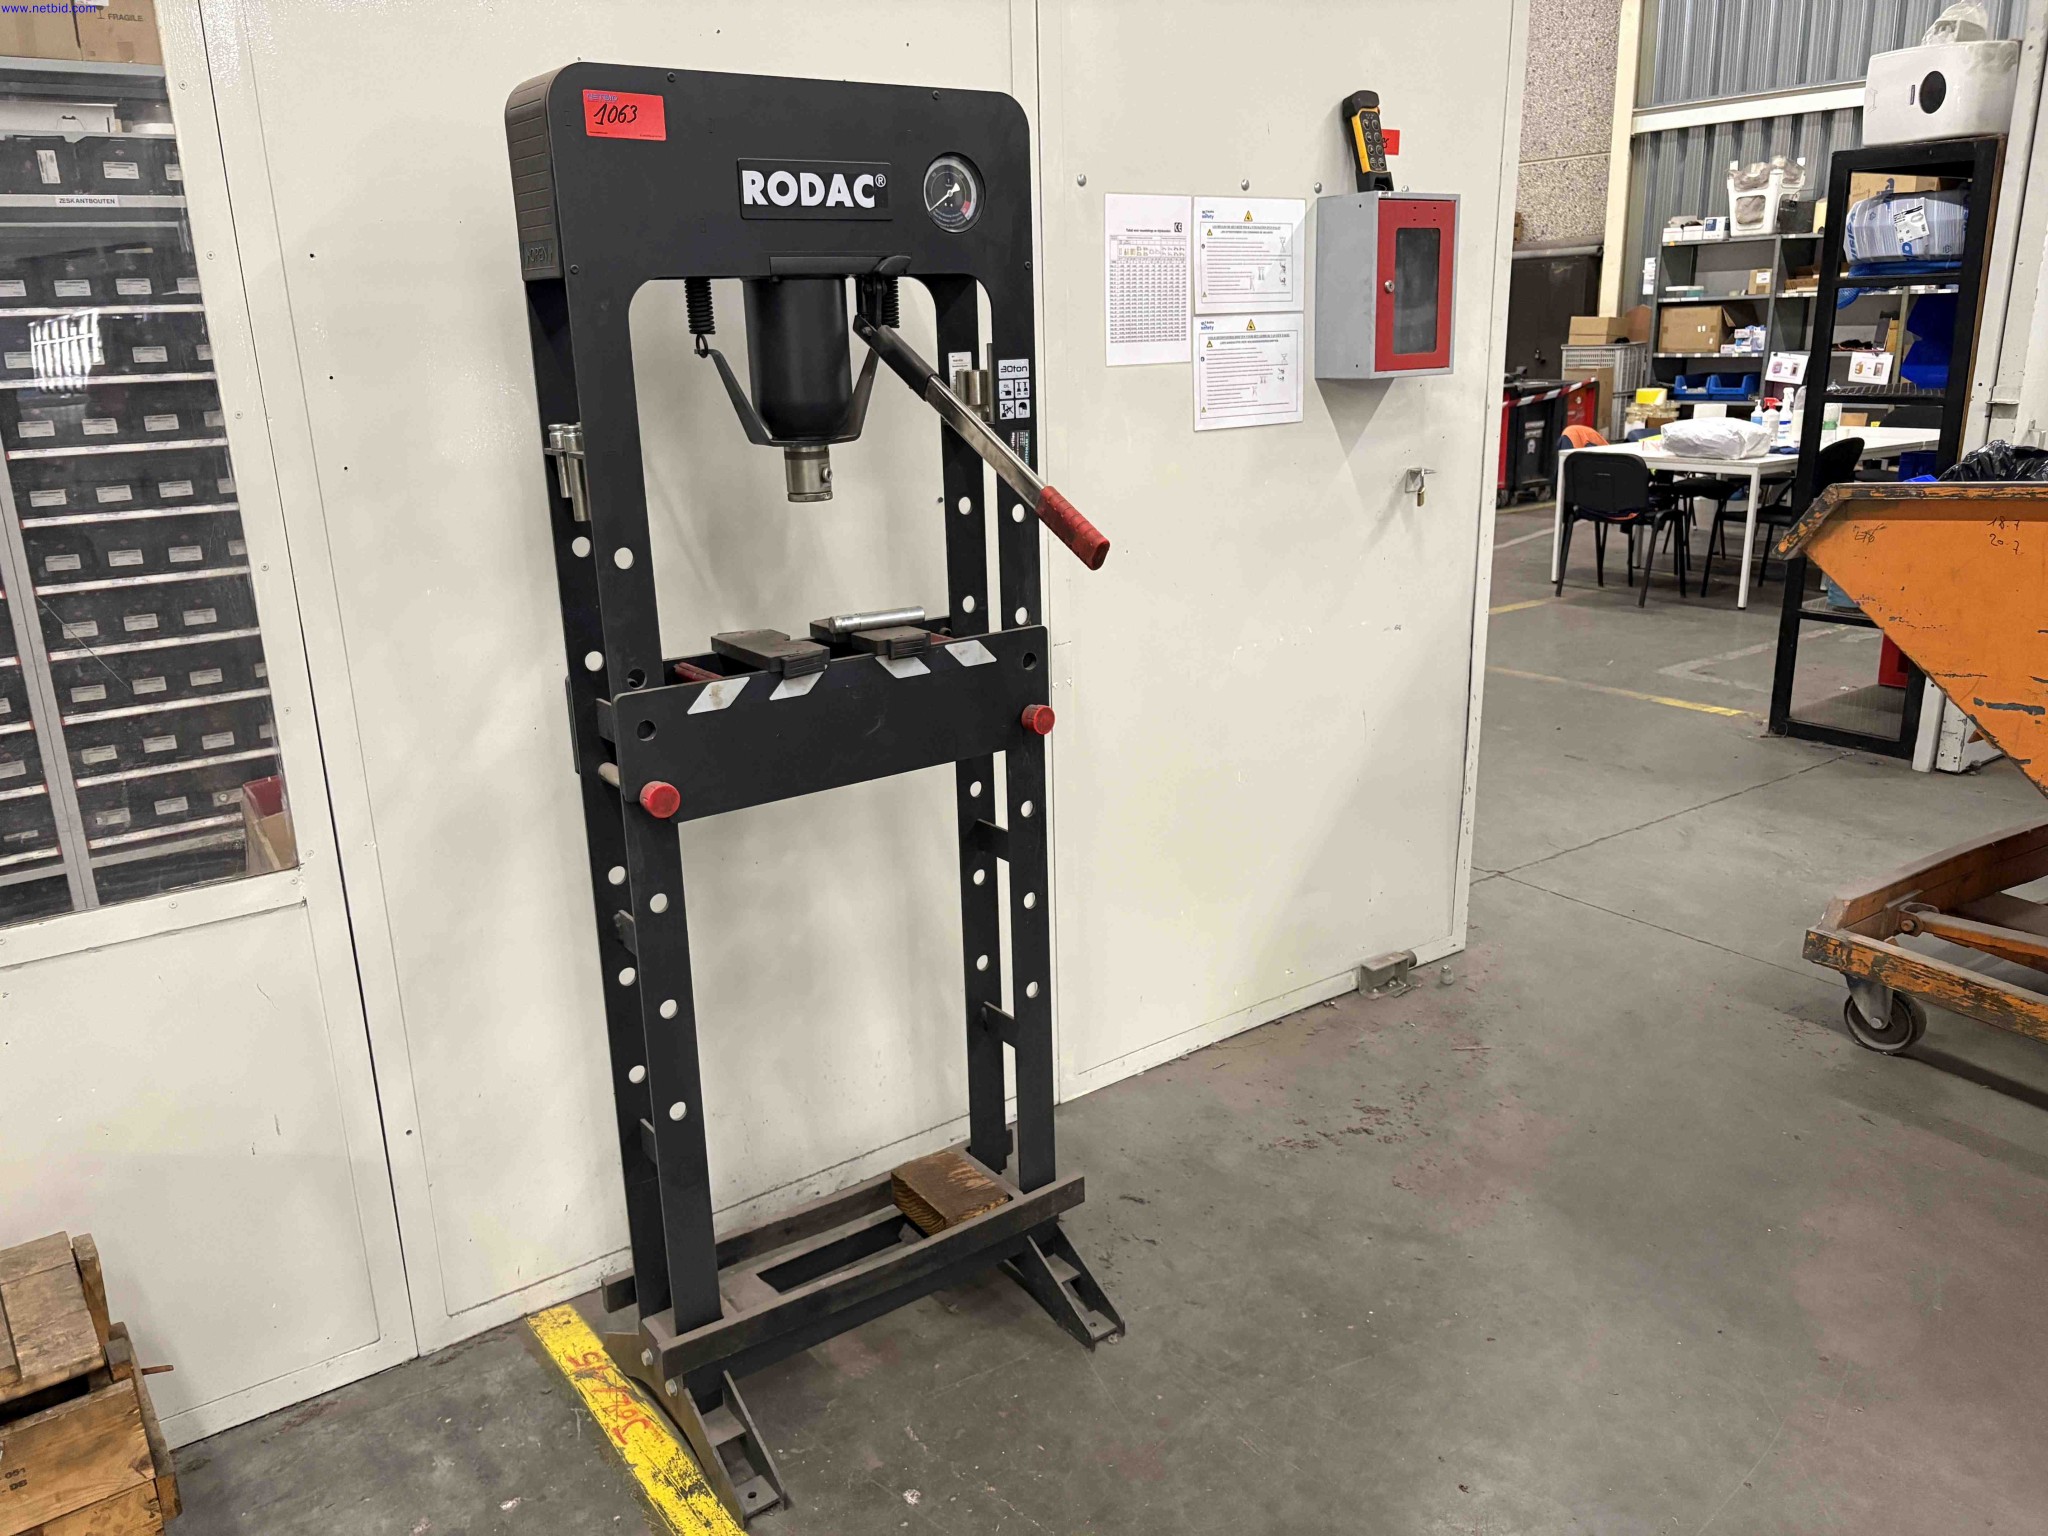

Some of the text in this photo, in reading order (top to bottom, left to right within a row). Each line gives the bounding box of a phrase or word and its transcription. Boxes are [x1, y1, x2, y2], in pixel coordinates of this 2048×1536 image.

[107, 13, 144, 22] FRAGILE
[593, 103, 638, 126] 1063
[58, 197, 116, 205] ZESKANTBOUTEN
